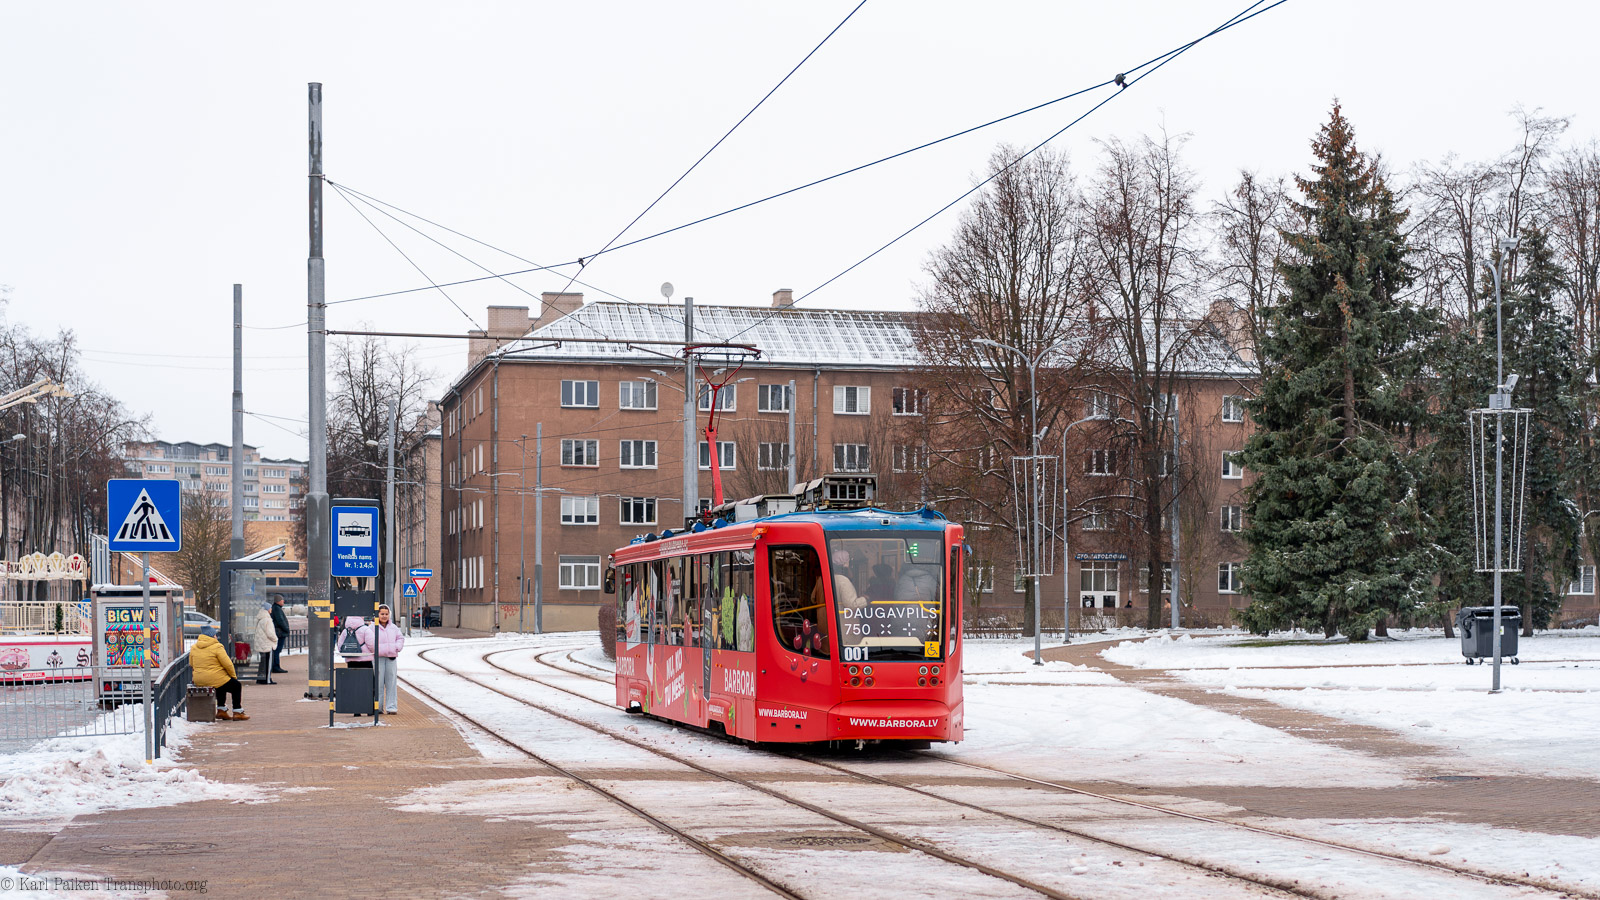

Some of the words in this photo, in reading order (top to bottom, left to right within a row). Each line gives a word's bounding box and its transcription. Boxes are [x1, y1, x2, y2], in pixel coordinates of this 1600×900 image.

[108, 609, 130, 622] BIG
[131, 609, 156, 622] WN
[844, 607, 938, 619] DAUGAVPILS
[844, 624, 871, 635] 750
[844, 646, 869, 661] 001
[724, 668, 755, 697] BARBORA
[665, 683, 672, 708] TU
[758, 708, 808, 720] WWW.BARBORA.LV
[849, 718, 939, 728] WWW.BARBORA.LV
